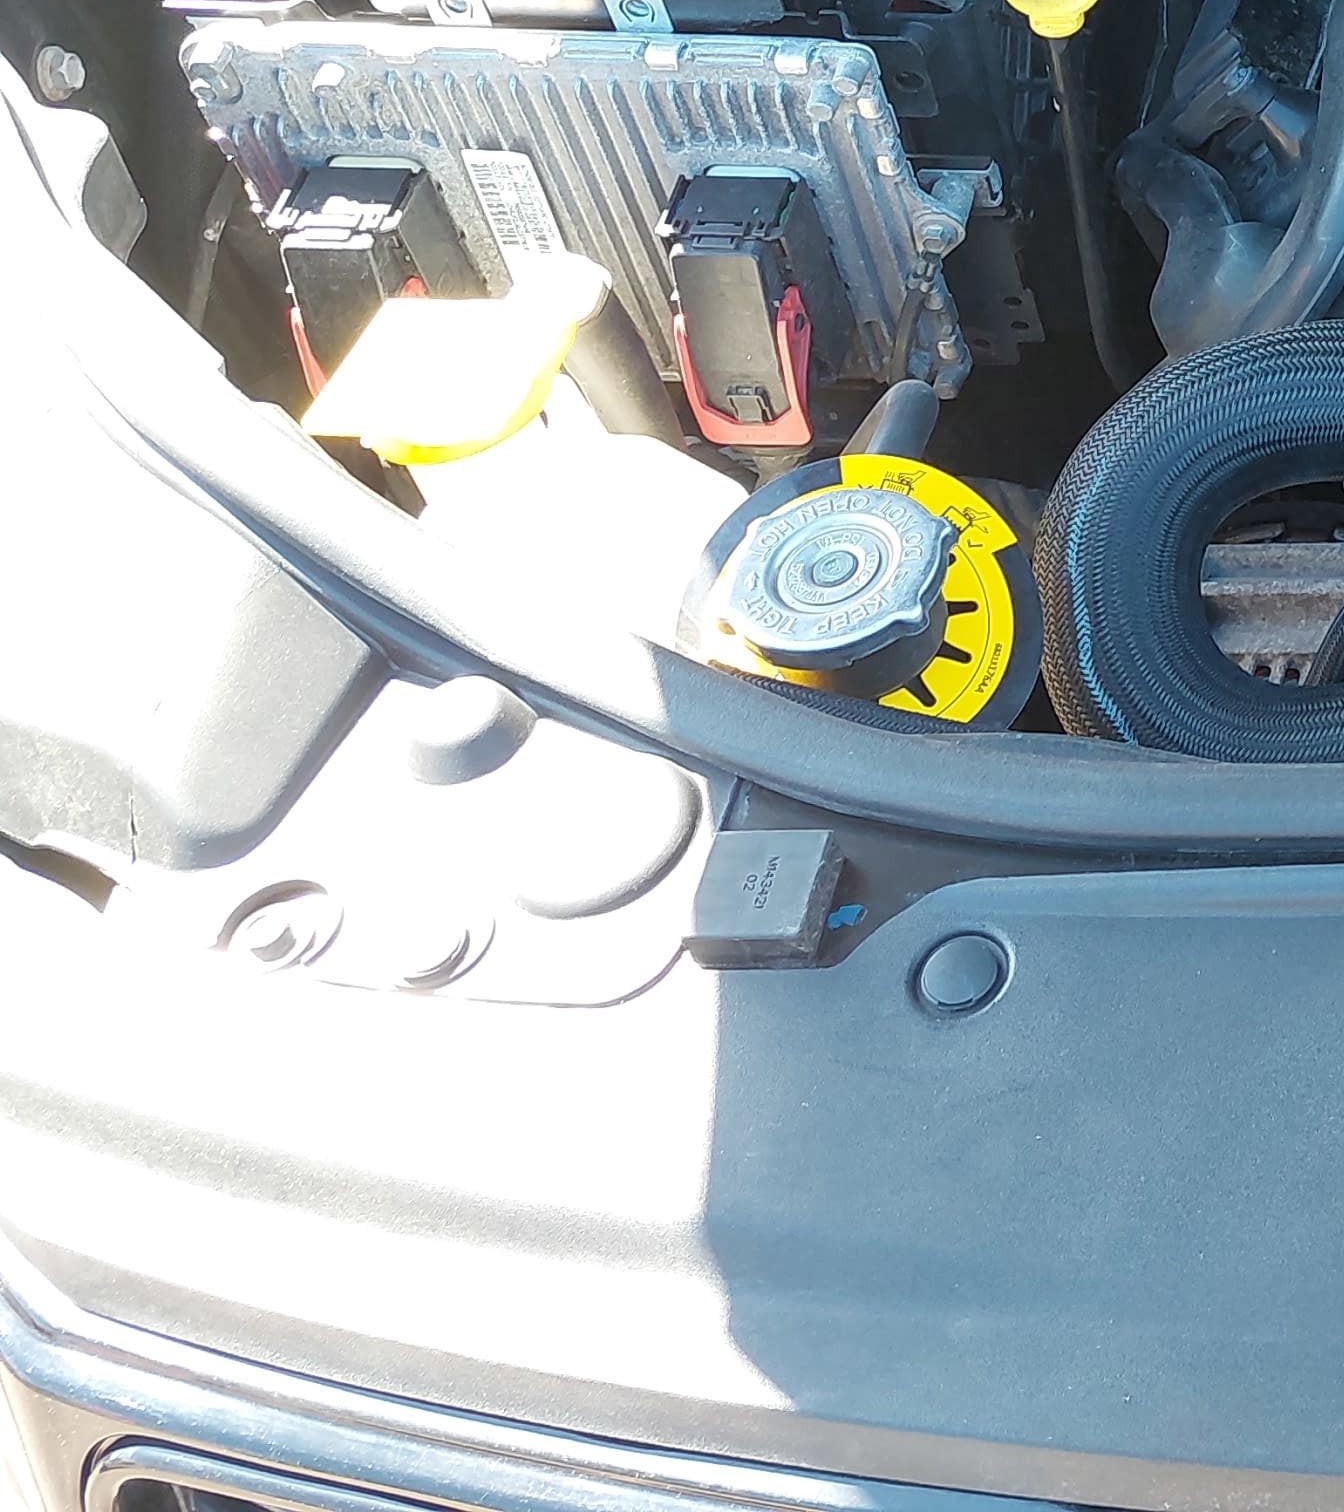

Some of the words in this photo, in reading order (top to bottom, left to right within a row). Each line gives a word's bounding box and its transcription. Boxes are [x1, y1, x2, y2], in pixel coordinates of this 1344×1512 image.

[798, 494, 871, 525] OPEN
[875, 499, 918, 535] NOT
[752, 520, 796, 563] HOT
[815, 592, 890, 636] KEEP
